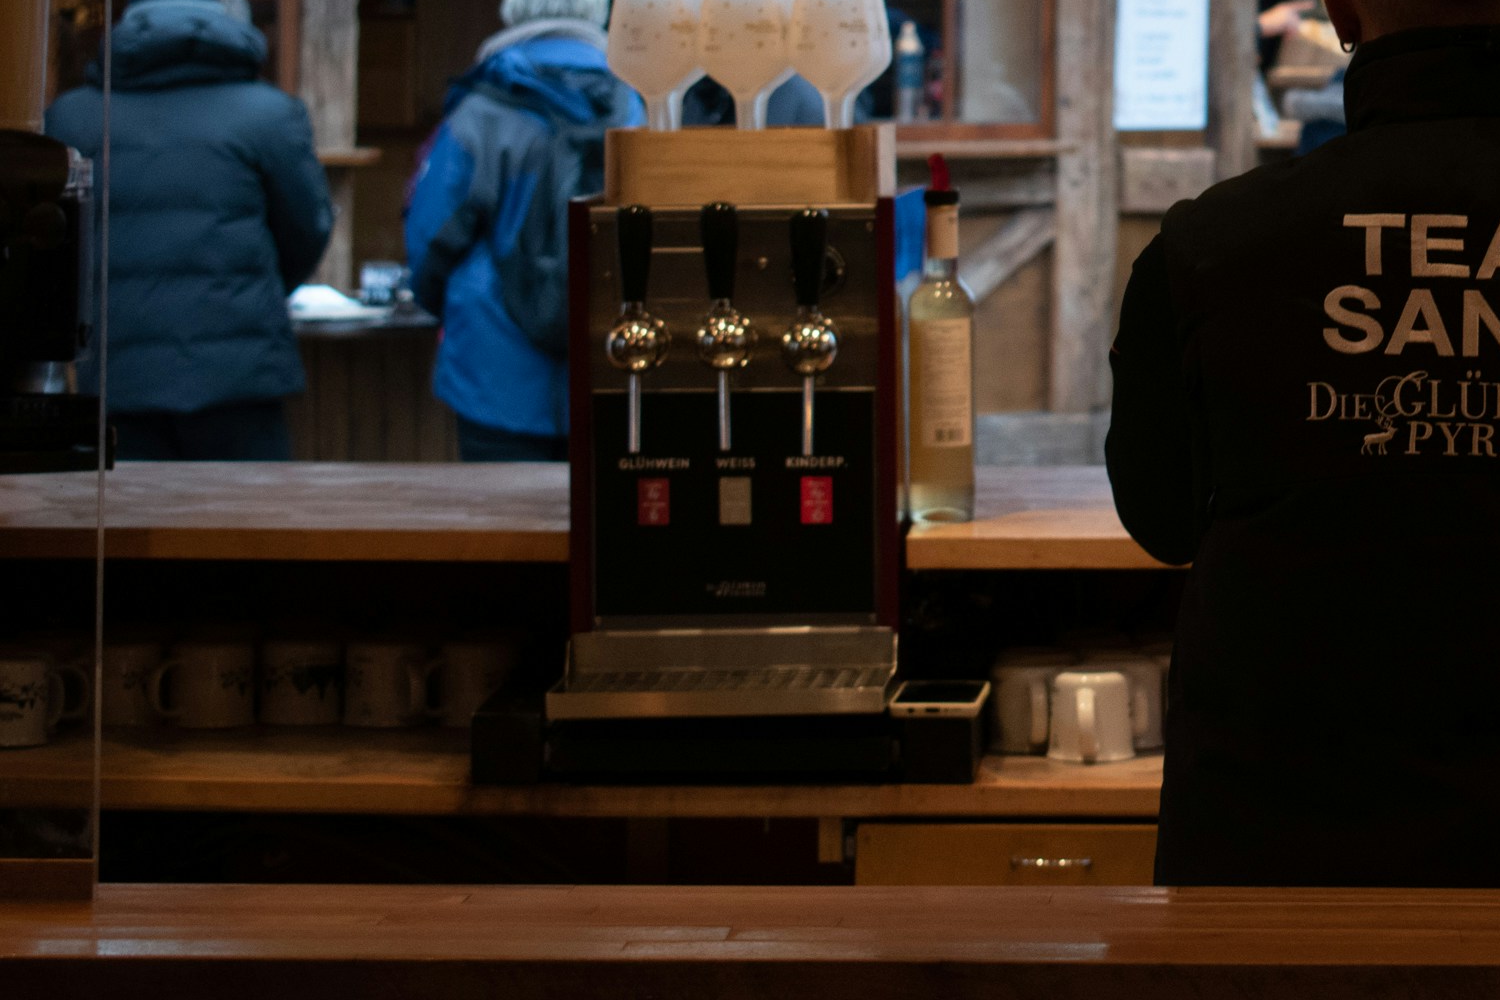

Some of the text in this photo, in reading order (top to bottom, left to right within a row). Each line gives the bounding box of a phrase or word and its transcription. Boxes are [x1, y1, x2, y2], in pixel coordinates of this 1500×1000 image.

[618, 455, 691, 471] GLÜHWEIN
[715, 456, 756, 470] WEISS
[785, 455, 848, 470] KINDERP.
